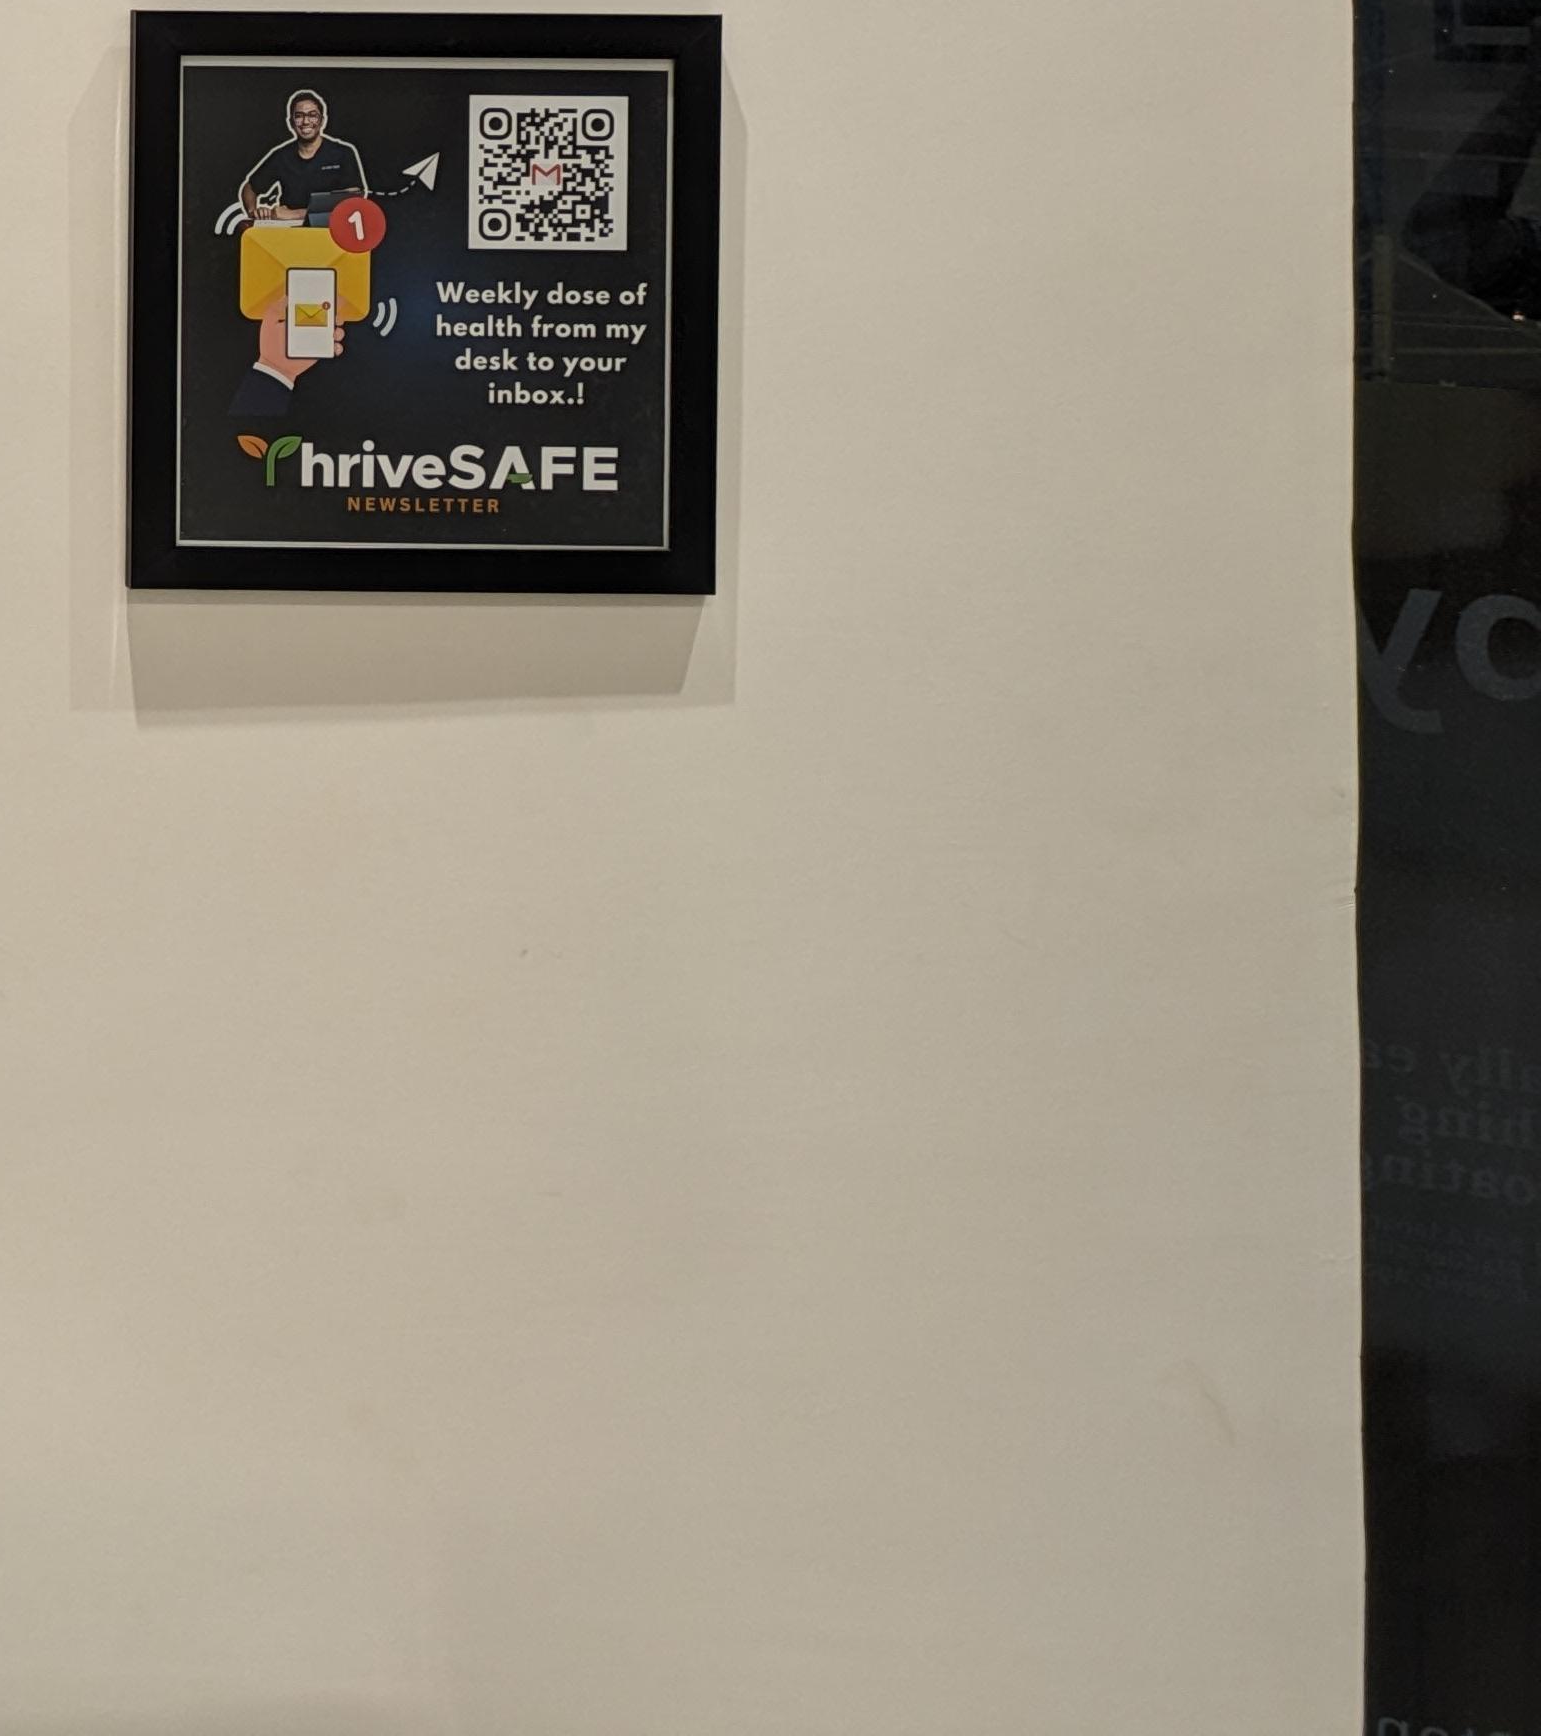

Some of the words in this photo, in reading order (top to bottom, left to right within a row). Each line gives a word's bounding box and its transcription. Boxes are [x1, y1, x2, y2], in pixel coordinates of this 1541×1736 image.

[348, 211, 364, 240] 1
[436, 281, 539, 310] Weekly
[546, 282, 611, 305] dose
[619, 282, 648, 305] of
[436, 314, 522, 337] health
[531, 315, 597, 338] from
[606, 323, 647, 345] my
[455, 347, 519, 371] desk
[526, 352, 554, 371] to
[562, 355, 628, 377] your
[488, 381, 585, 405] inbox.!
[347, 497, 500, 513] NEWSLETTER
